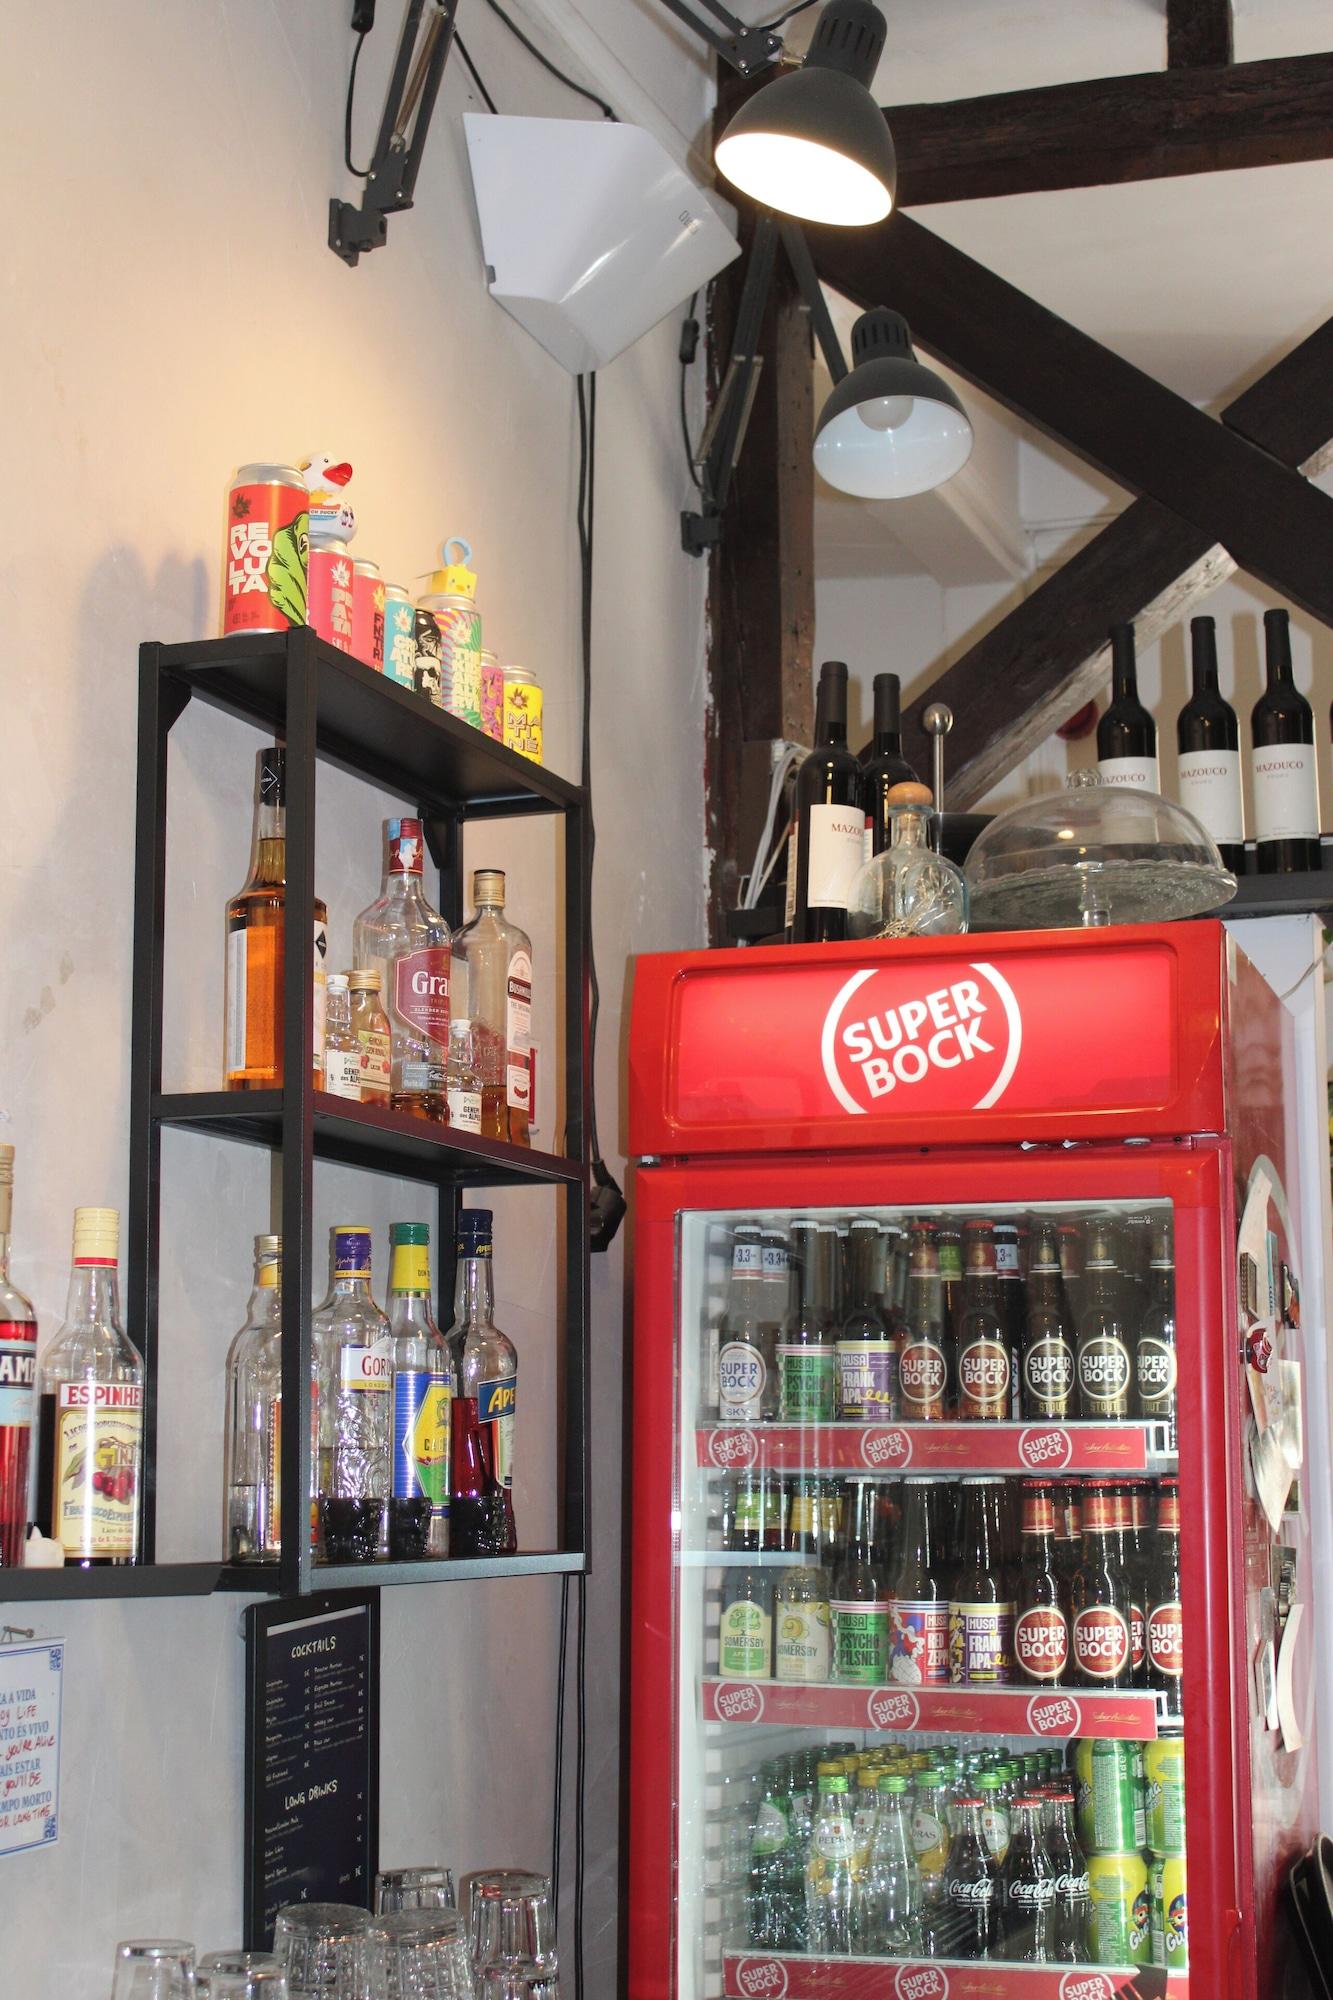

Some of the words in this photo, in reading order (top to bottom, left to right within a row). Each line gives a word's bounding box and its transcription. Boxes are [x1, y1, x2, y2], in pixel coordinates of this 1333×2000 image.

[230, 522, 269, 544] RE
[230, 539, 272, 561] VO
[229, 557, 268, 579] LU
[229, 574, 268, 595] TA
[1255, 760, 1304, 773] MAZOUCO
[842, 980, 988, 1062] SUPER
[861, 1016, 995, 1098] BOCK
[721, 1362, 758, 1375] SUPER
[786, 1356, 812, 1370] MUSA
[842, 1354, 866, 1367] MUSA
[902, 1359, 942, 1373] SUPER
[963, 1358, 1006, 1372] SUPER
[1030, 1356, 1072, 1370] SUPER
[1082, 1356, 1124, 1369] SUPER
[1138, 1356, 1169, 1369] UPER
[722, 1375, 756, 1388] BOCK
[842, 1371, 876, 1388] FRANK
[903, 1372, 940, 1386] BOCK
[964, 1372, 1004, 1385] BOCK
[1032, 1370, 1071, 1384] BOCK
[1084, 1368, 1124, 1382] BOCK
[842, 1388, 862, 1404] APA
[714, 1432, 750, 1453] SUPER
[866, 1432, 902, 1454] SUPER
[1024, 1432, 1062, 1454] SUPER
[719, 1442, 752, 1463] BOCK
[872, 1444, 906, 1464] BOCK
[1030, 1442, 1065, 1464] BOCK
[838, 1614, 866, 1628] MUSA
[969, 1618, 996, 1630] MUSA
[724, 1636, 764, 1648] SOMERSBY
[840, 1633, 880, 1648] PSYCHO
[928, 1633, 944, 1649] RED
[1018, 1626, 1066, 1642] SUPER
[1076, 1626, 1123, 1642] SUPER
[291, 1636, 337, 1658] COCKTAILS
[969, 1635, 1002, 1651] FRANK
[1021, 1642, 1065, 1658] BOCK
[1078, 1641, 1122, 1656] BOCK
[840, 1650, 880, 1666] PILSNER
[969, 1653, 990, 1669] APA
[16, 1688, 36, 1702] VIDA
[720, 1686, 756, 1708] SUPER
[724, 1697, 758, 1718] BOCK
[872, 1694, 910, 1714] SUPER
[1032, 1700, 1072, 1722] SUPER
[878, 1705, 912, 1725] BOCK
[1038, 1710, 1074, 1732] BOCK
[29, 1720, 50, 1736] VIVO
[16, 1758, 41, 1774] ESTAR
[22, 1790, 52, 1809] MORTO
[284, 1791, 306, 1810] LONG
[308, 1779, 338, 1802] DRINKS
[950, 1878, 994, 1898] Coca-Cola
[1008, 1878, 1054, 1898] Coca-Cola
[742, 1963, 779, 1984] SUPER
[900, 1970, 938, 1991] SUPER
[747, 1973, 782, 1994] BOCK
[906, 1980, 942, 2000] BOCK
[1065, 1977, 1105, 1998] SUPER
